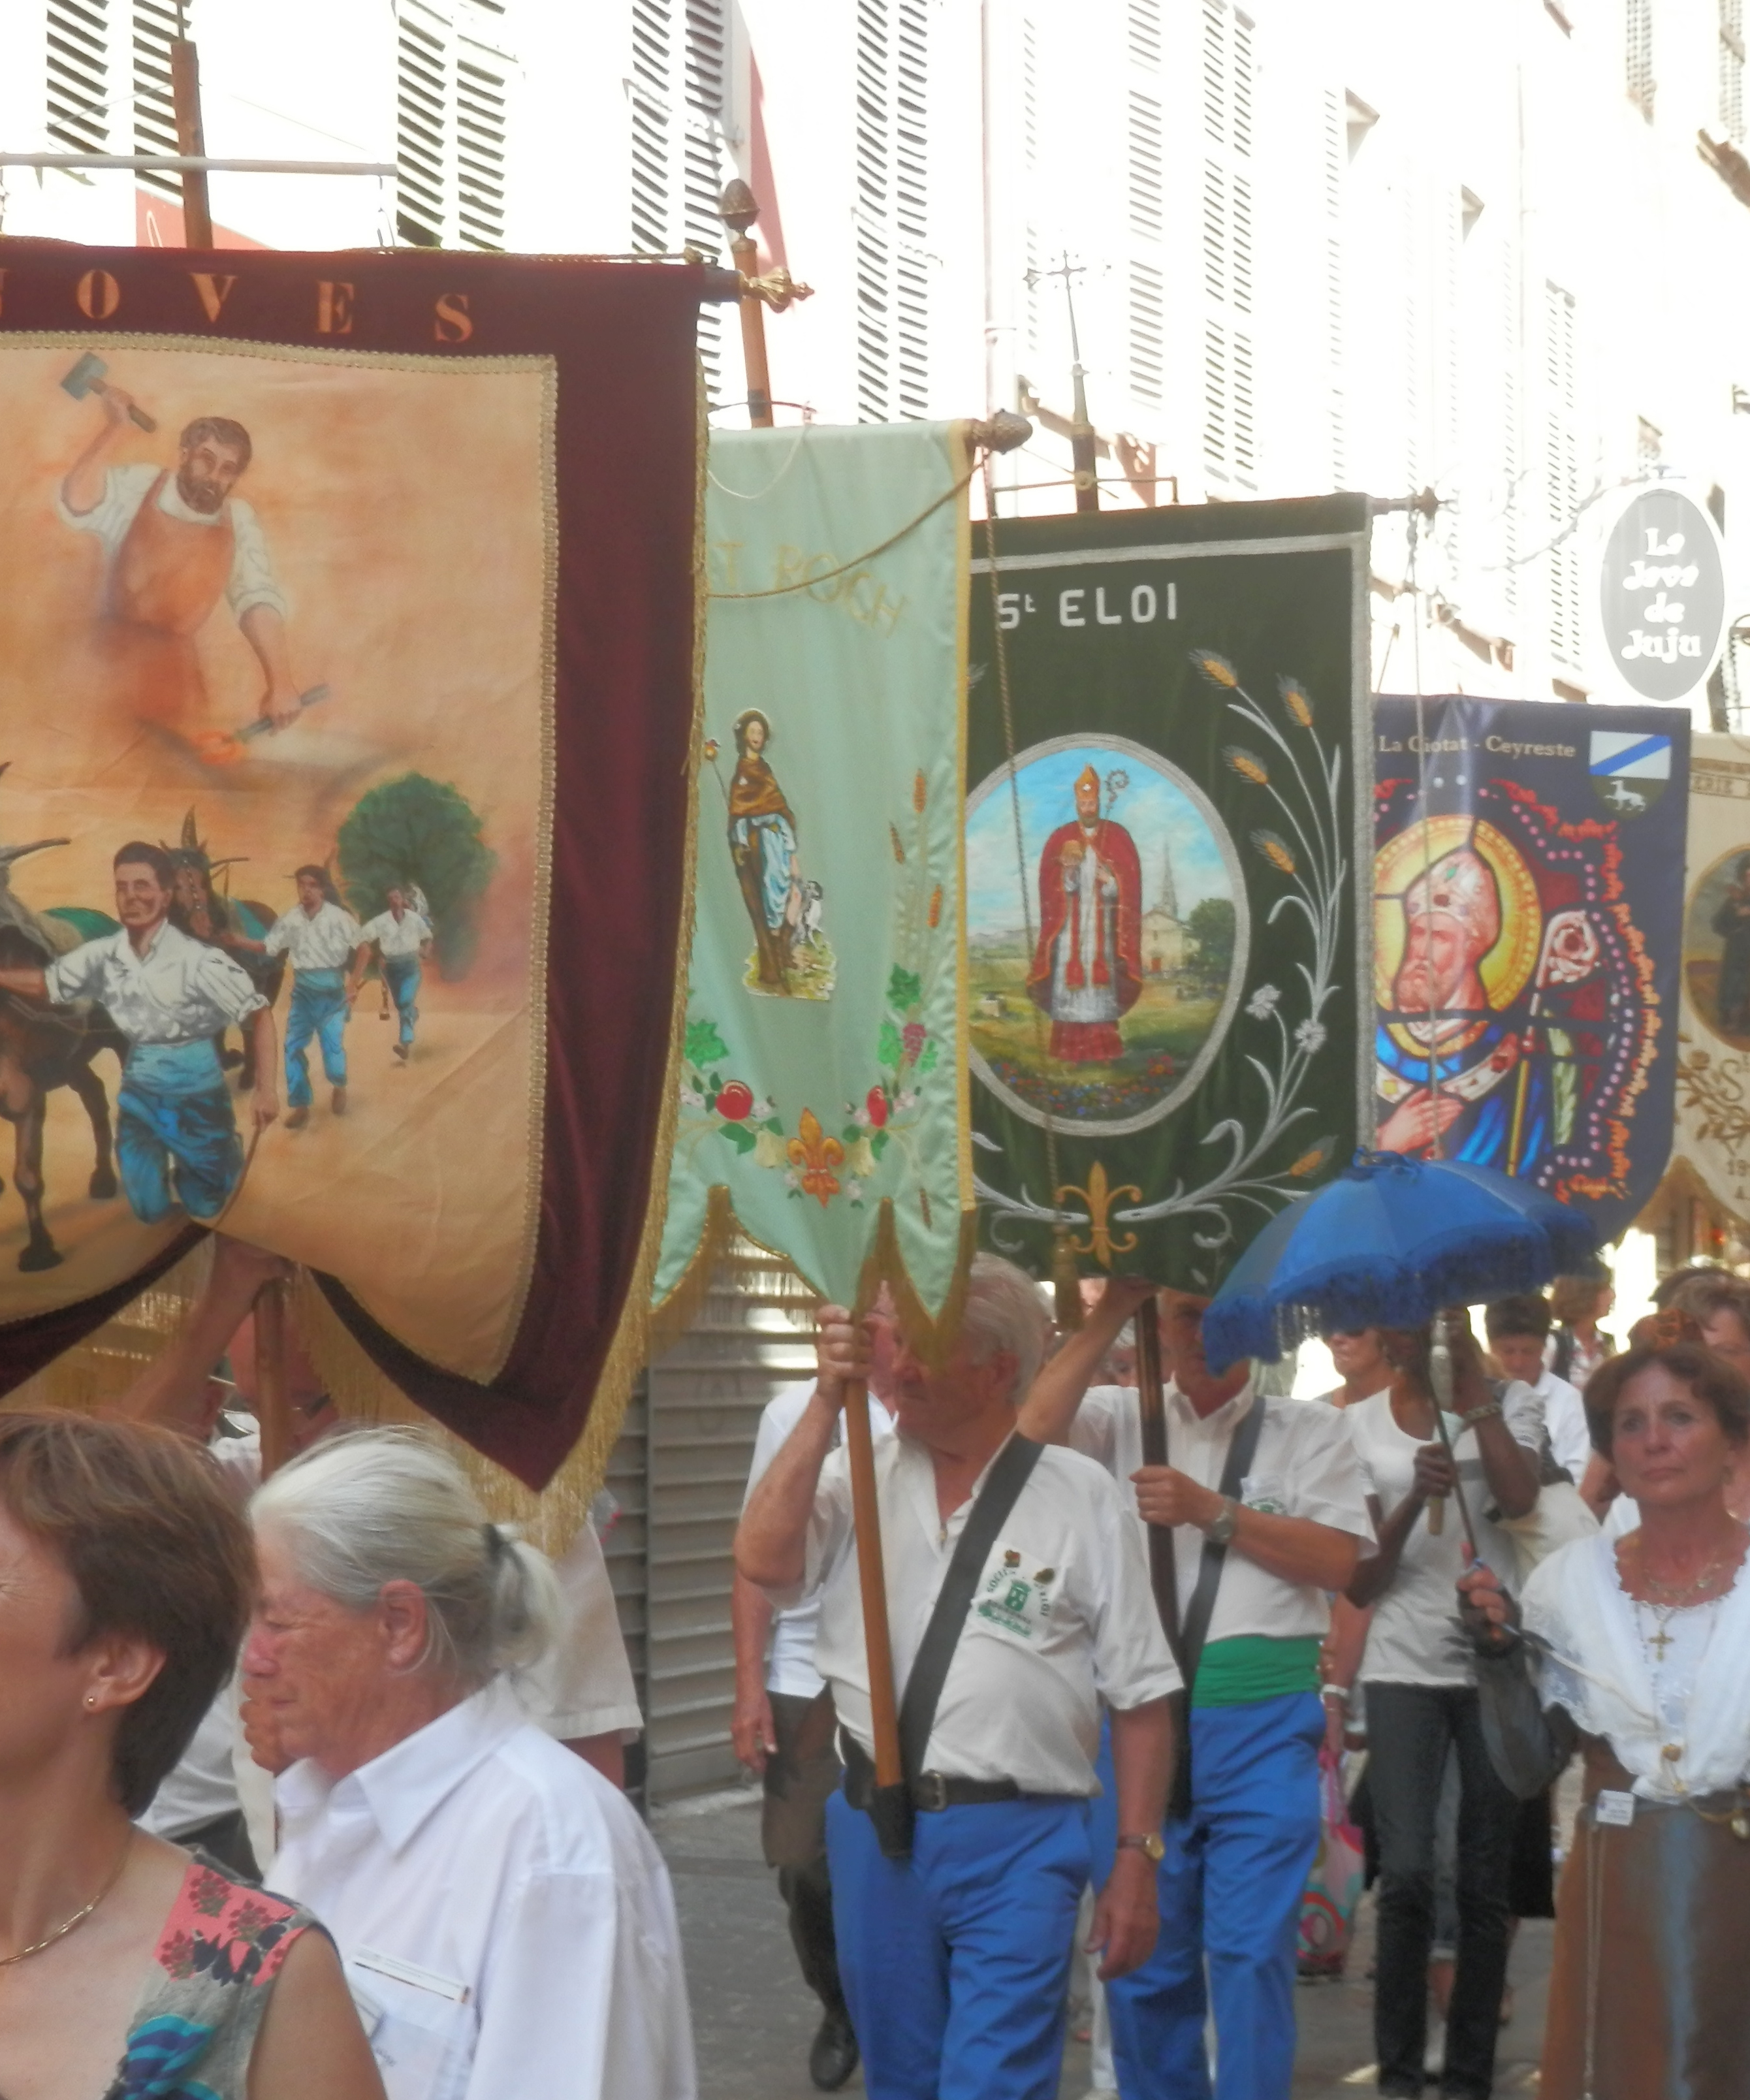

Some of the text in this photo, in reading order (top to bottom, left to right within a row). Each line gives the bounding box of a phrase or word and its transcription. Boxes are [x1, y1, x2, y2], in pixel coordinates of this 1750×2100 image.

[0, 268, 473, 343] OVES
[997, 582, 1177, 629] St ELOI
[1378, 735, 1403, 752] La
[1485, 735, 1576, 760] Ceyreste
